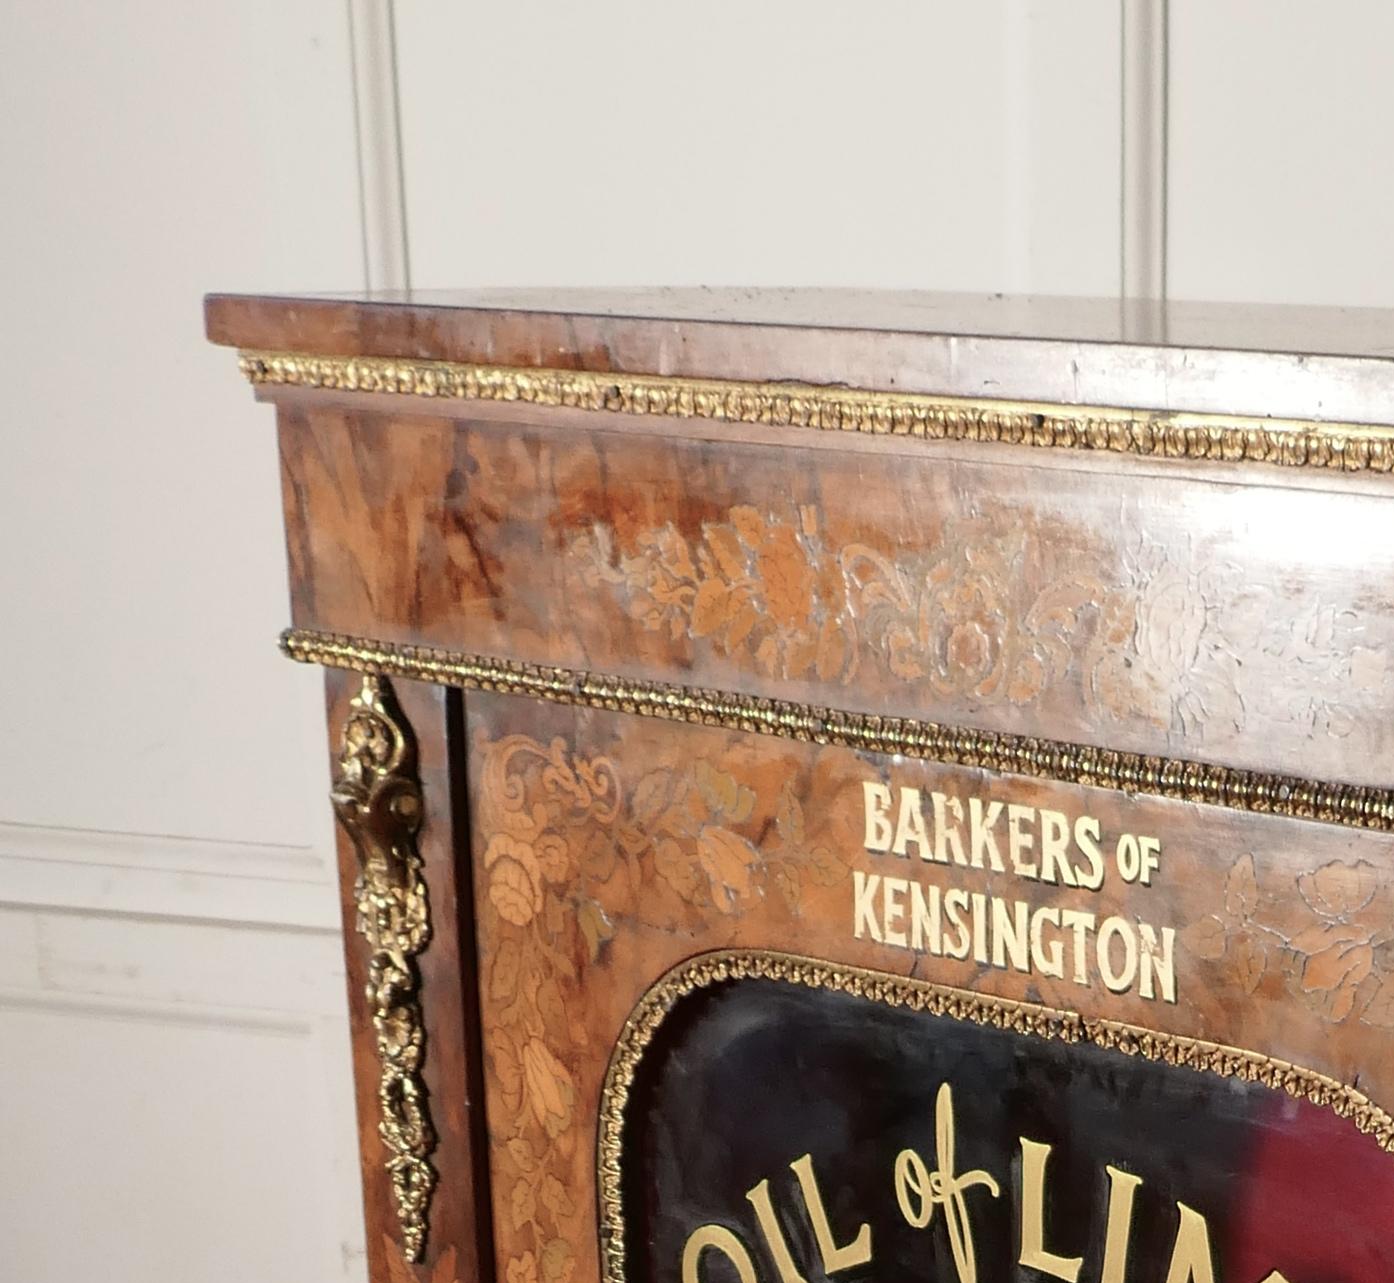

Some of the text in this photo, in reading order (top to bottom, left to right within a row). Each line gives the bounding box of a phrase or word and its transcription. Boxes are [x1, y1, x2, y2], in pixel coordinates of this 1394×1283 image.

[862, 782, 1161, 891] BARKERS OF
[853, 871, 1177, 1004] KENSINGTON
